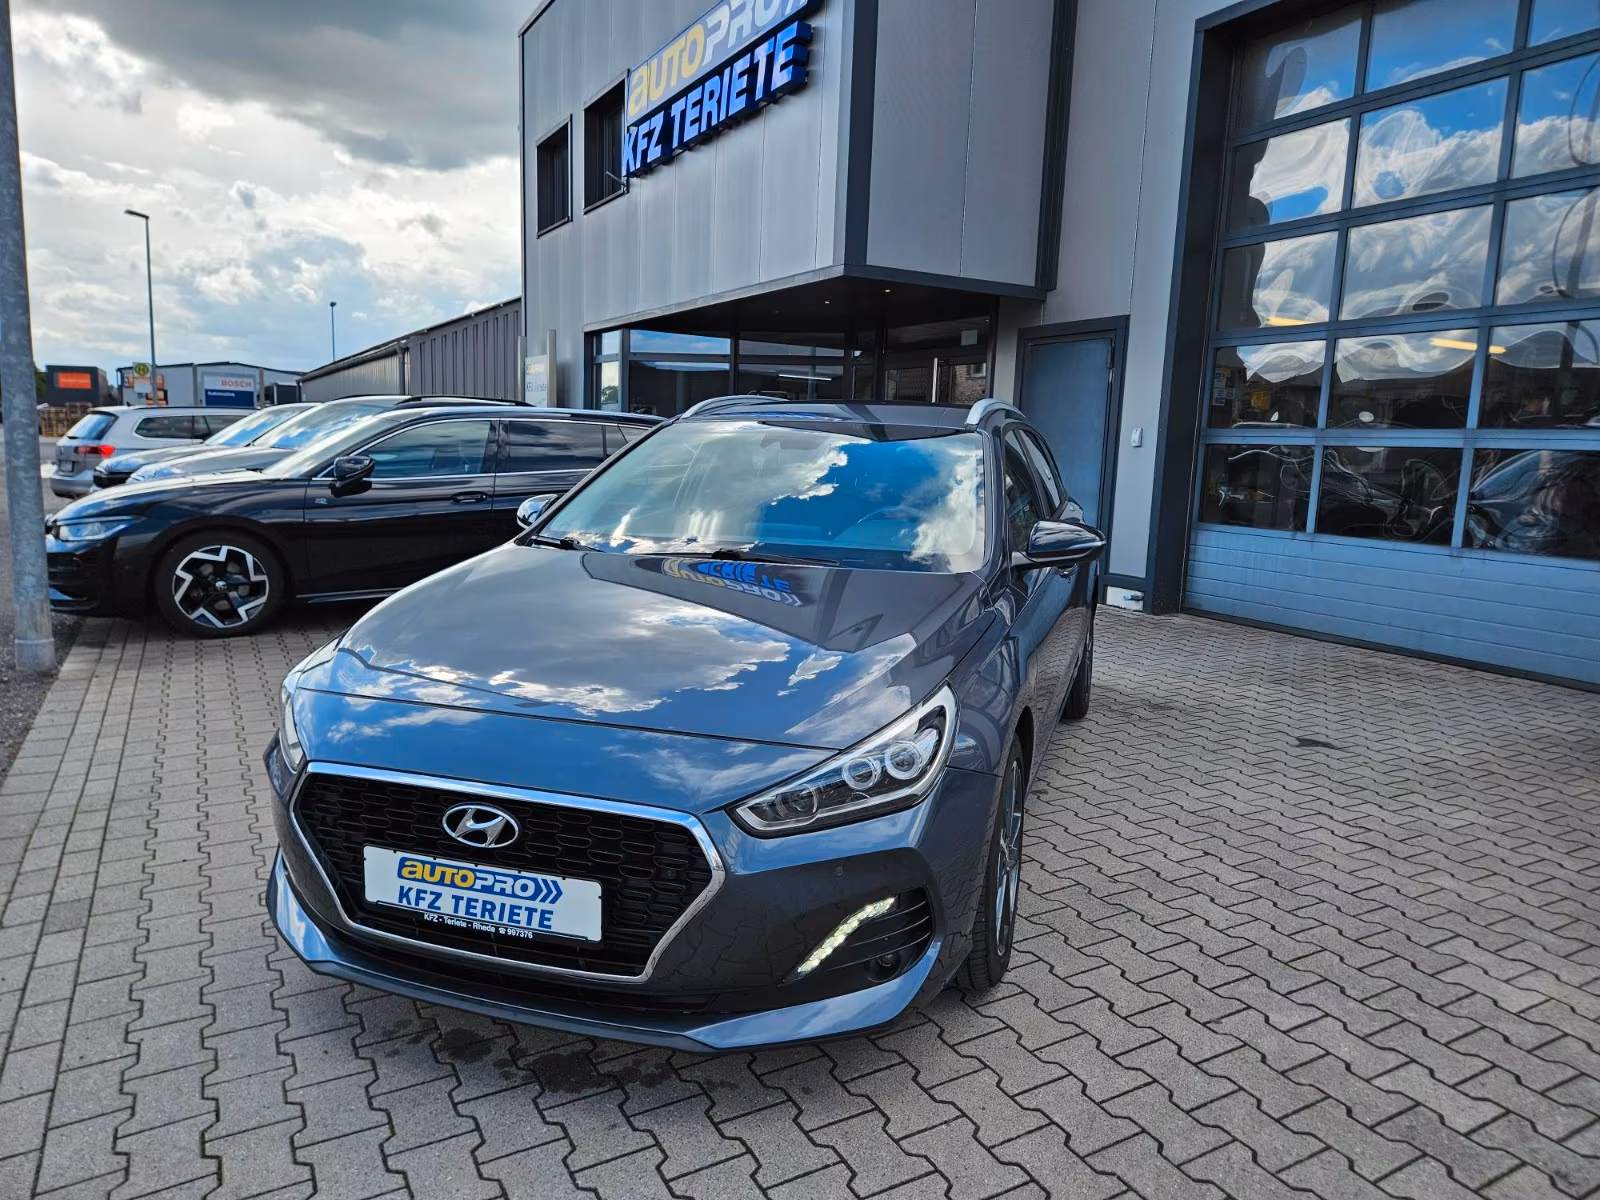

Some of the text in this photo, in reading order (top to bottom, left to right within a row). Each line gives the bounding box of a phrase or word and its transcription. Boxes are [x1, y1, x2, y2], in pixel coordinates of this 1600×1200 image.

[622, 20, 799, 177] KFZ TERIETE
[221, 379, 253, 388] BOSCH
[398, 885, 554, 929] KFZ TERIETE
[423, 913, 438, 923] KFZ
[443, 916, 467, 928] Teriete
[472, 922, 496, 933] Rhede
[507, 928, 533, 939] 997376
